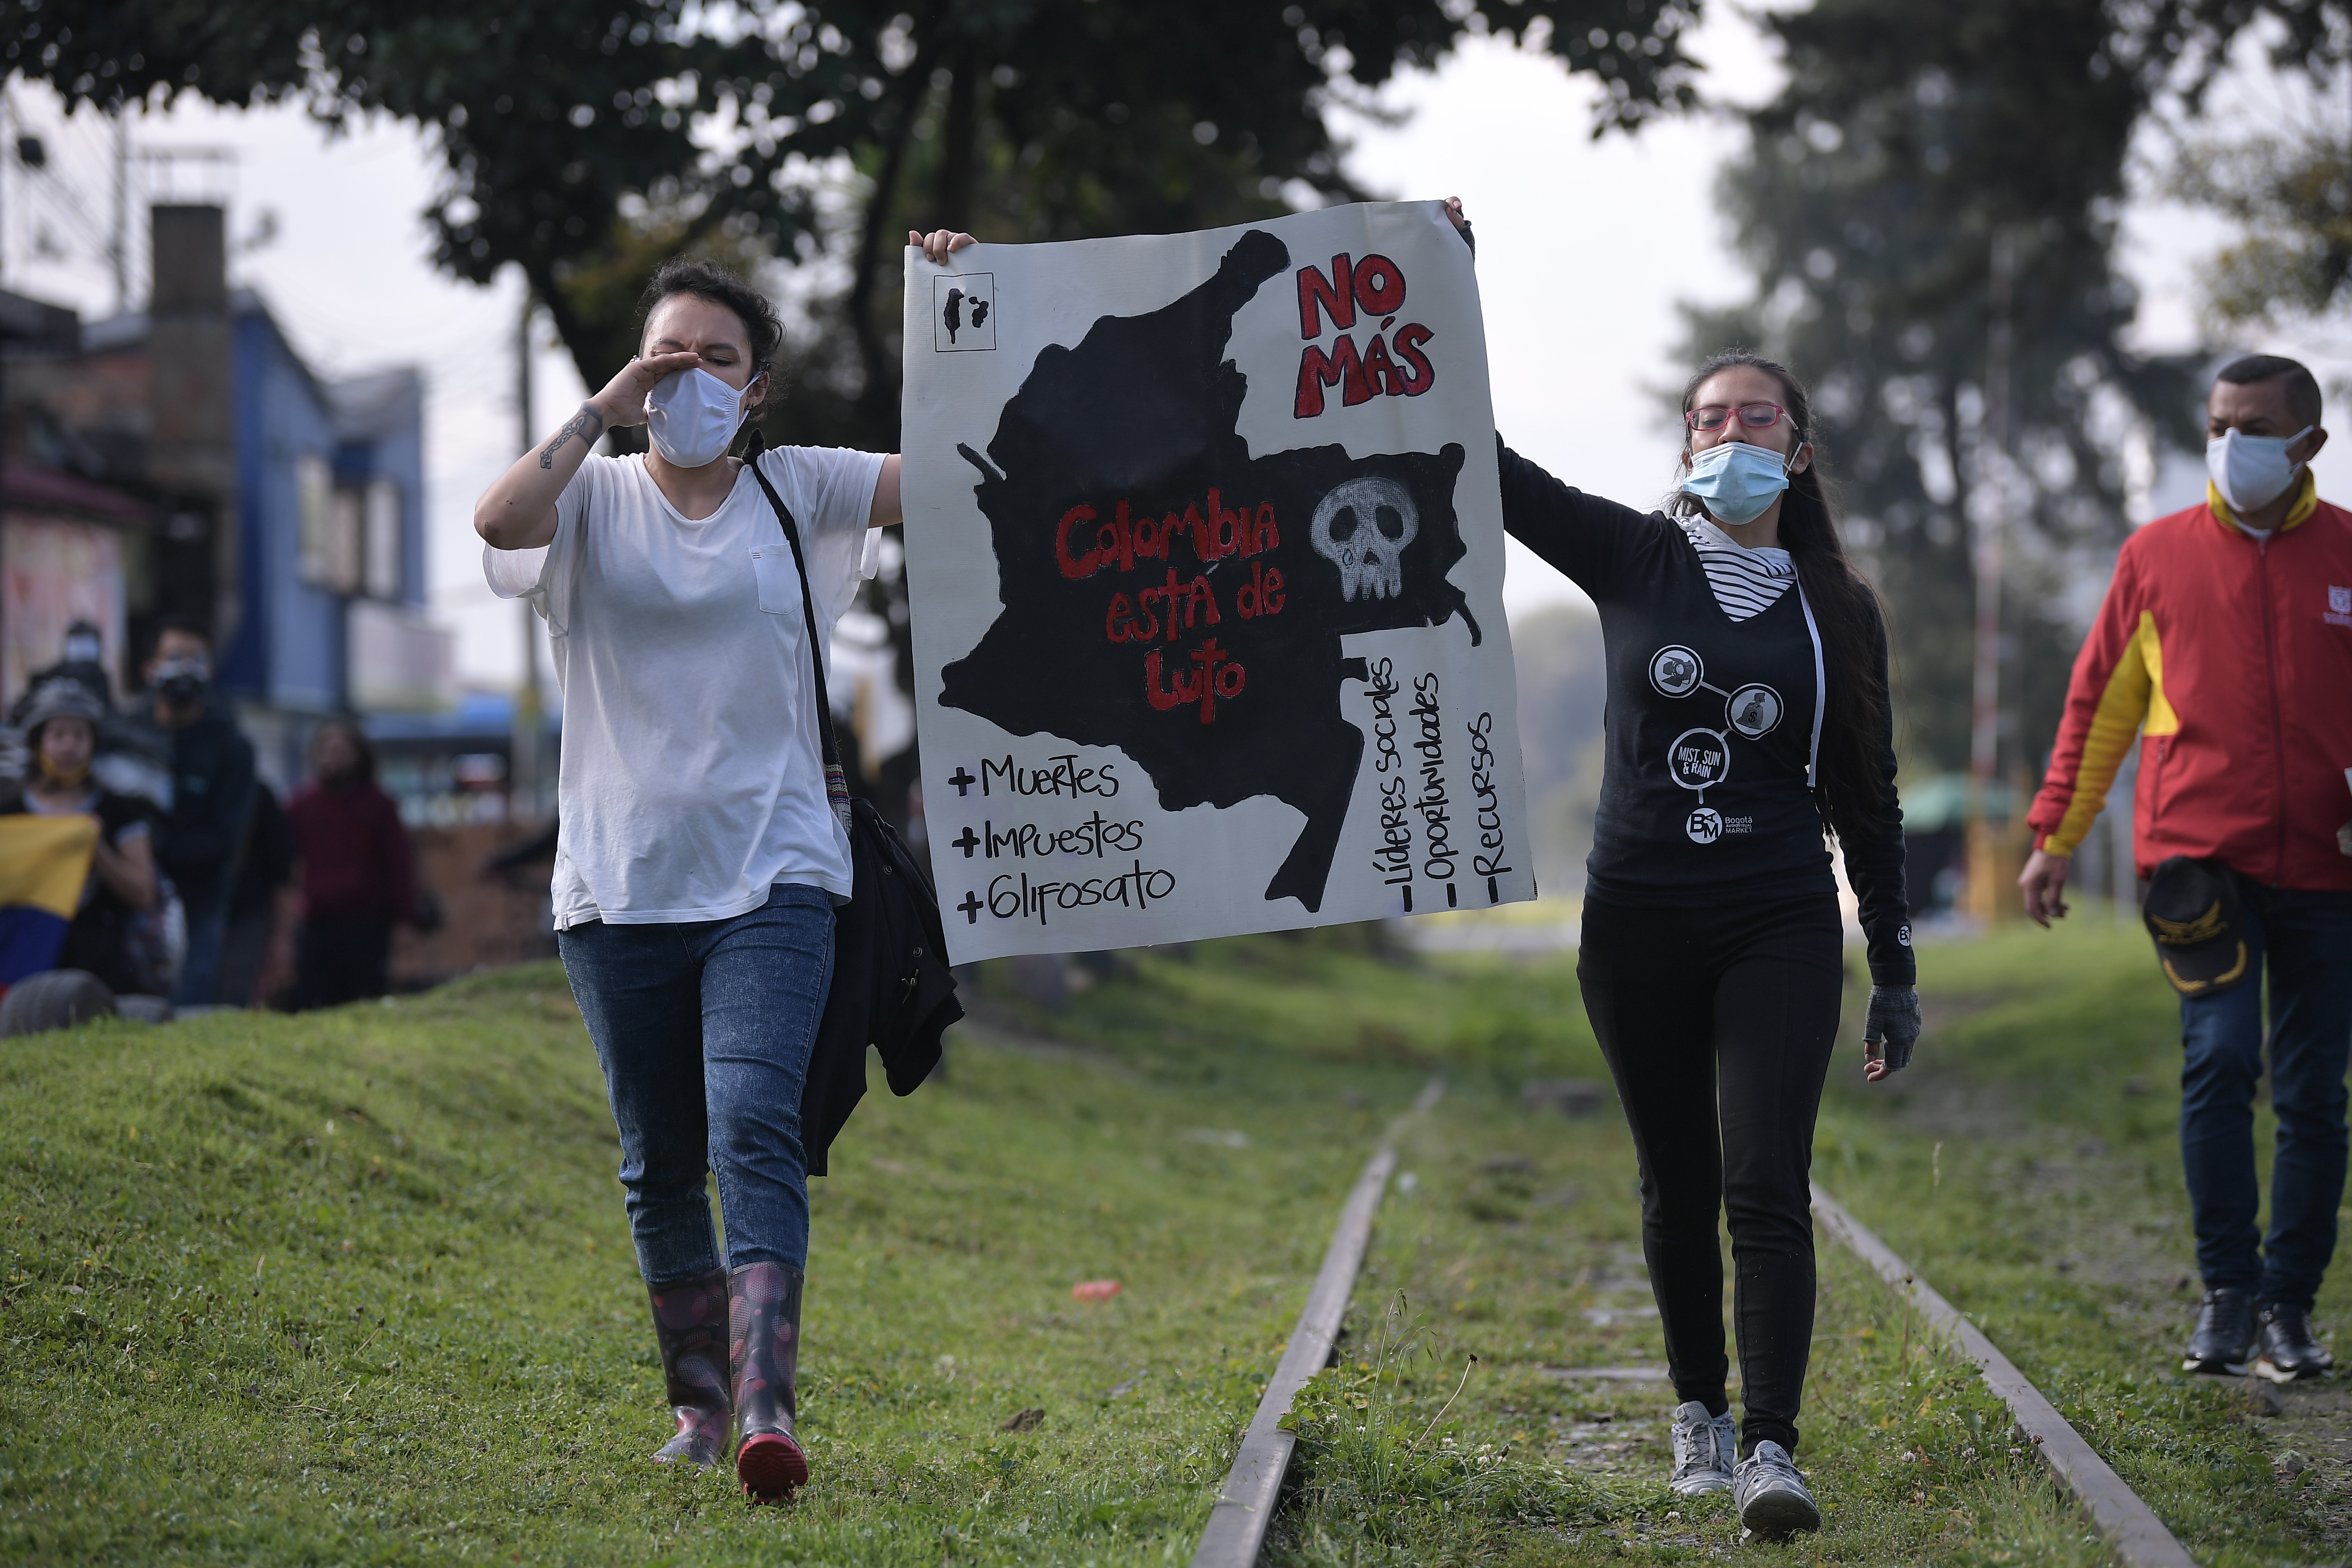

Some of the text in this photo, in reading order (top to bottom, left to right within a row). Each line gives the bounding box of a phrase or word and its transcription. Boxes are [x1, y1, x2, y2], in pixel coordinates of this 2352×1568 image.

[1296, 252, 1406, 340] NO
[1293, 316, 1435, 420] MÁS
[1237, 561, 1285, 619] de
[1144, 638, 1246, 724] Luto
[1678, 746, 1721, 767] MIST, SUN
[1683, 762, 1712, 779] & RAIN
[1725, 816, 1753, 824] Bogotá
